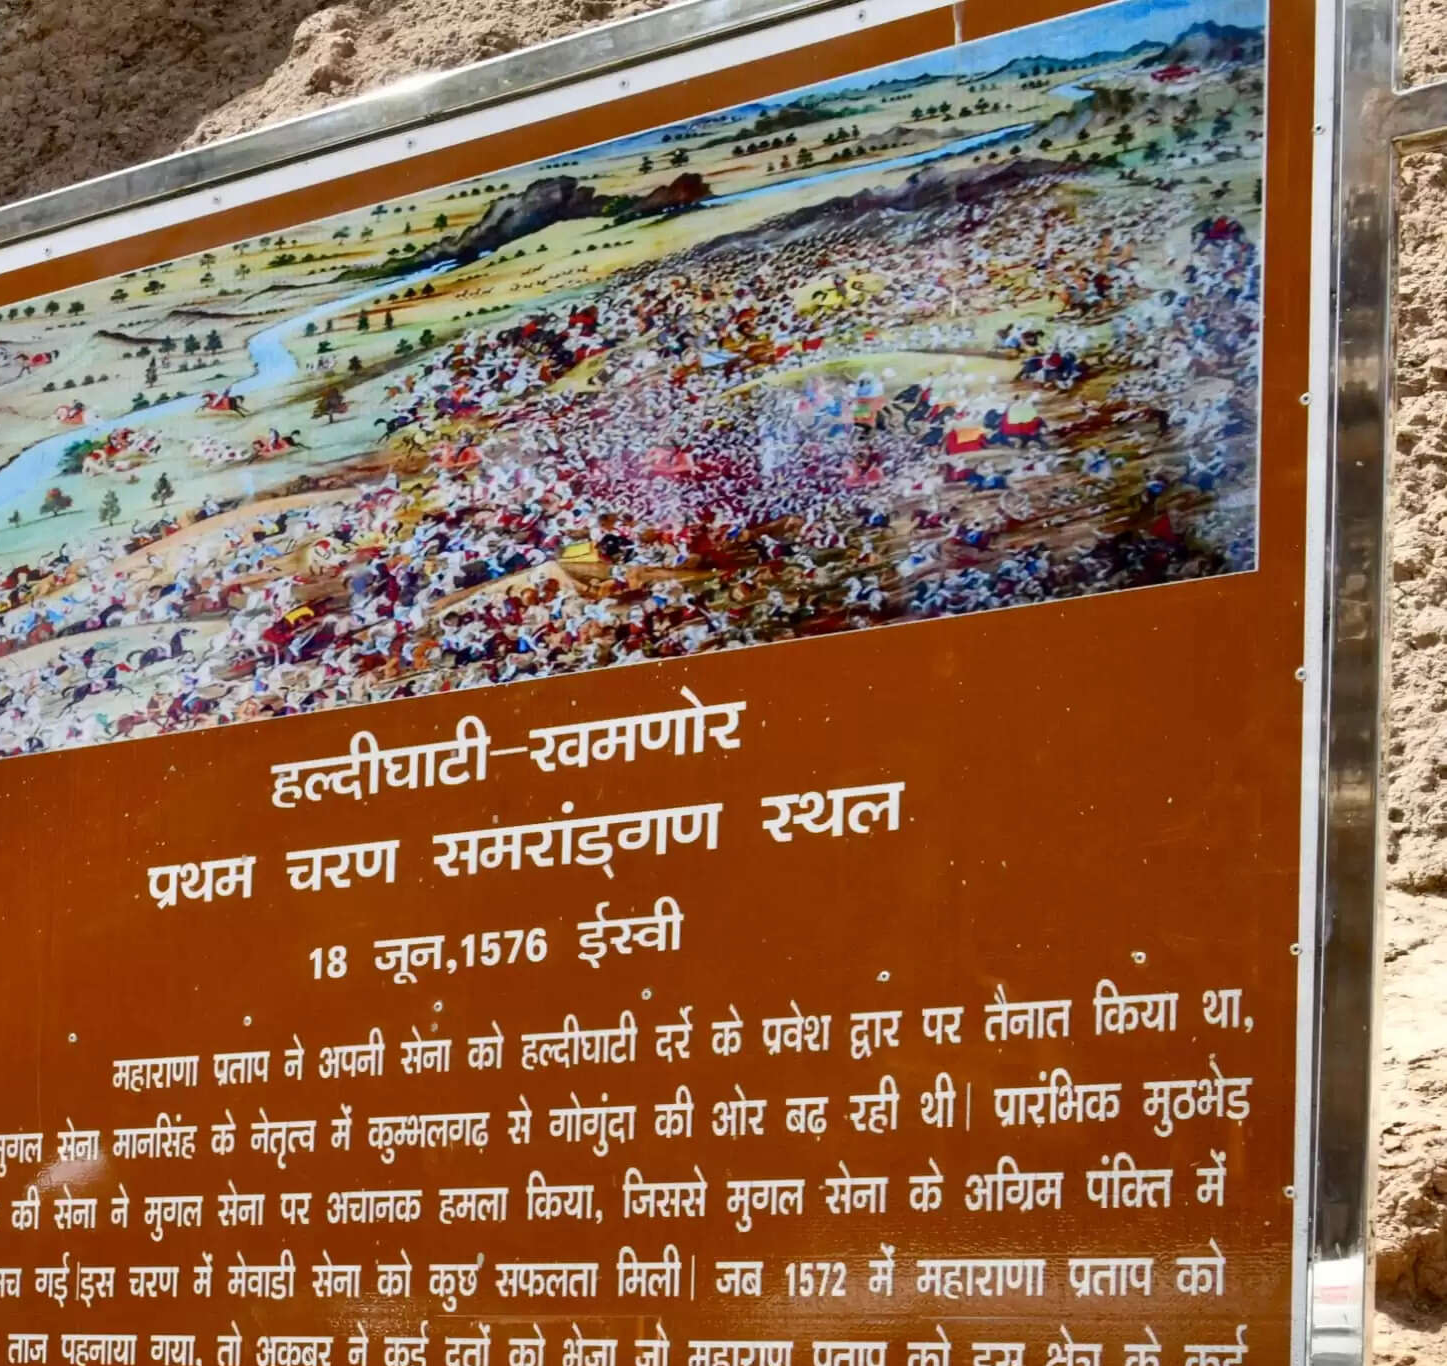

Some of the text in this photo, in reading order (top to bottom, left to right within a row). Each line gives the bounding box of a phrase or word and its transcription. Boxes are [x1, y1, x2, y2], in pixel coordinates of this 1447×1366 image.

[146, 854, 258, 910] प्रथम
[285, 839, 401, 892] चरण
[760, 780, 906, 843] स्थल
[309, 944, 348, 980] 18
[576, 895, 685, 969] ईस्वी
[112, 978, 1180, 1093] महाराणा ने अपनी को हल्दीघाटी के प्रवेश पर तैनात किया
[57, 1117, 101, 1162] सेना
[112, 1112, 199, 1160] मानसिंह
[250, 1107, 318, 1170] नेतृत्व
[330, 1103, 353, 1152] में
[548, 1090, 637, 1158] गोगुंदा
[653, 1084, 695, 1139] की
[849, 1074, 901, 1135] रही
[993, 1067, 1123, 1128] प्रारंभिक
[53, 1185, 99, 1230] सेना
[144, 1195, 204, 1242] मुगल
[280, 1192, 313, 1225] पर
[326, 1188, 423, 1225] अचानक
[438, 1186, 510, 1225] हमला
[525, 1169, 603, 1225] किया,
[621, 1164, 708, 1219] जिससे
[726, 1178, 806, 1233] मुगल
[824, 1159, 890, 1215] सेना
[964, 1154, 1065, 1213] अग्रिम
[1085, 1151, 1174, 1209] पंक्ति
[1196, 1148, 1227, 1207] में
[128, 1265, 181, 1298] चरण
[311, 1249, 363, 1298] सेना
[428, 1261, 484, 1313] कुछ
[494, 1262, 600, 1298] सफलता
[785, 1261, 847, 1297] 1572
[868, 1242, 896, 1296] में
[916, 1258, 1047, 1300] महाराणा
[1067, 1257, 1154, 1298] प्रताप
[7, 1333, 50, 1364] ताज
